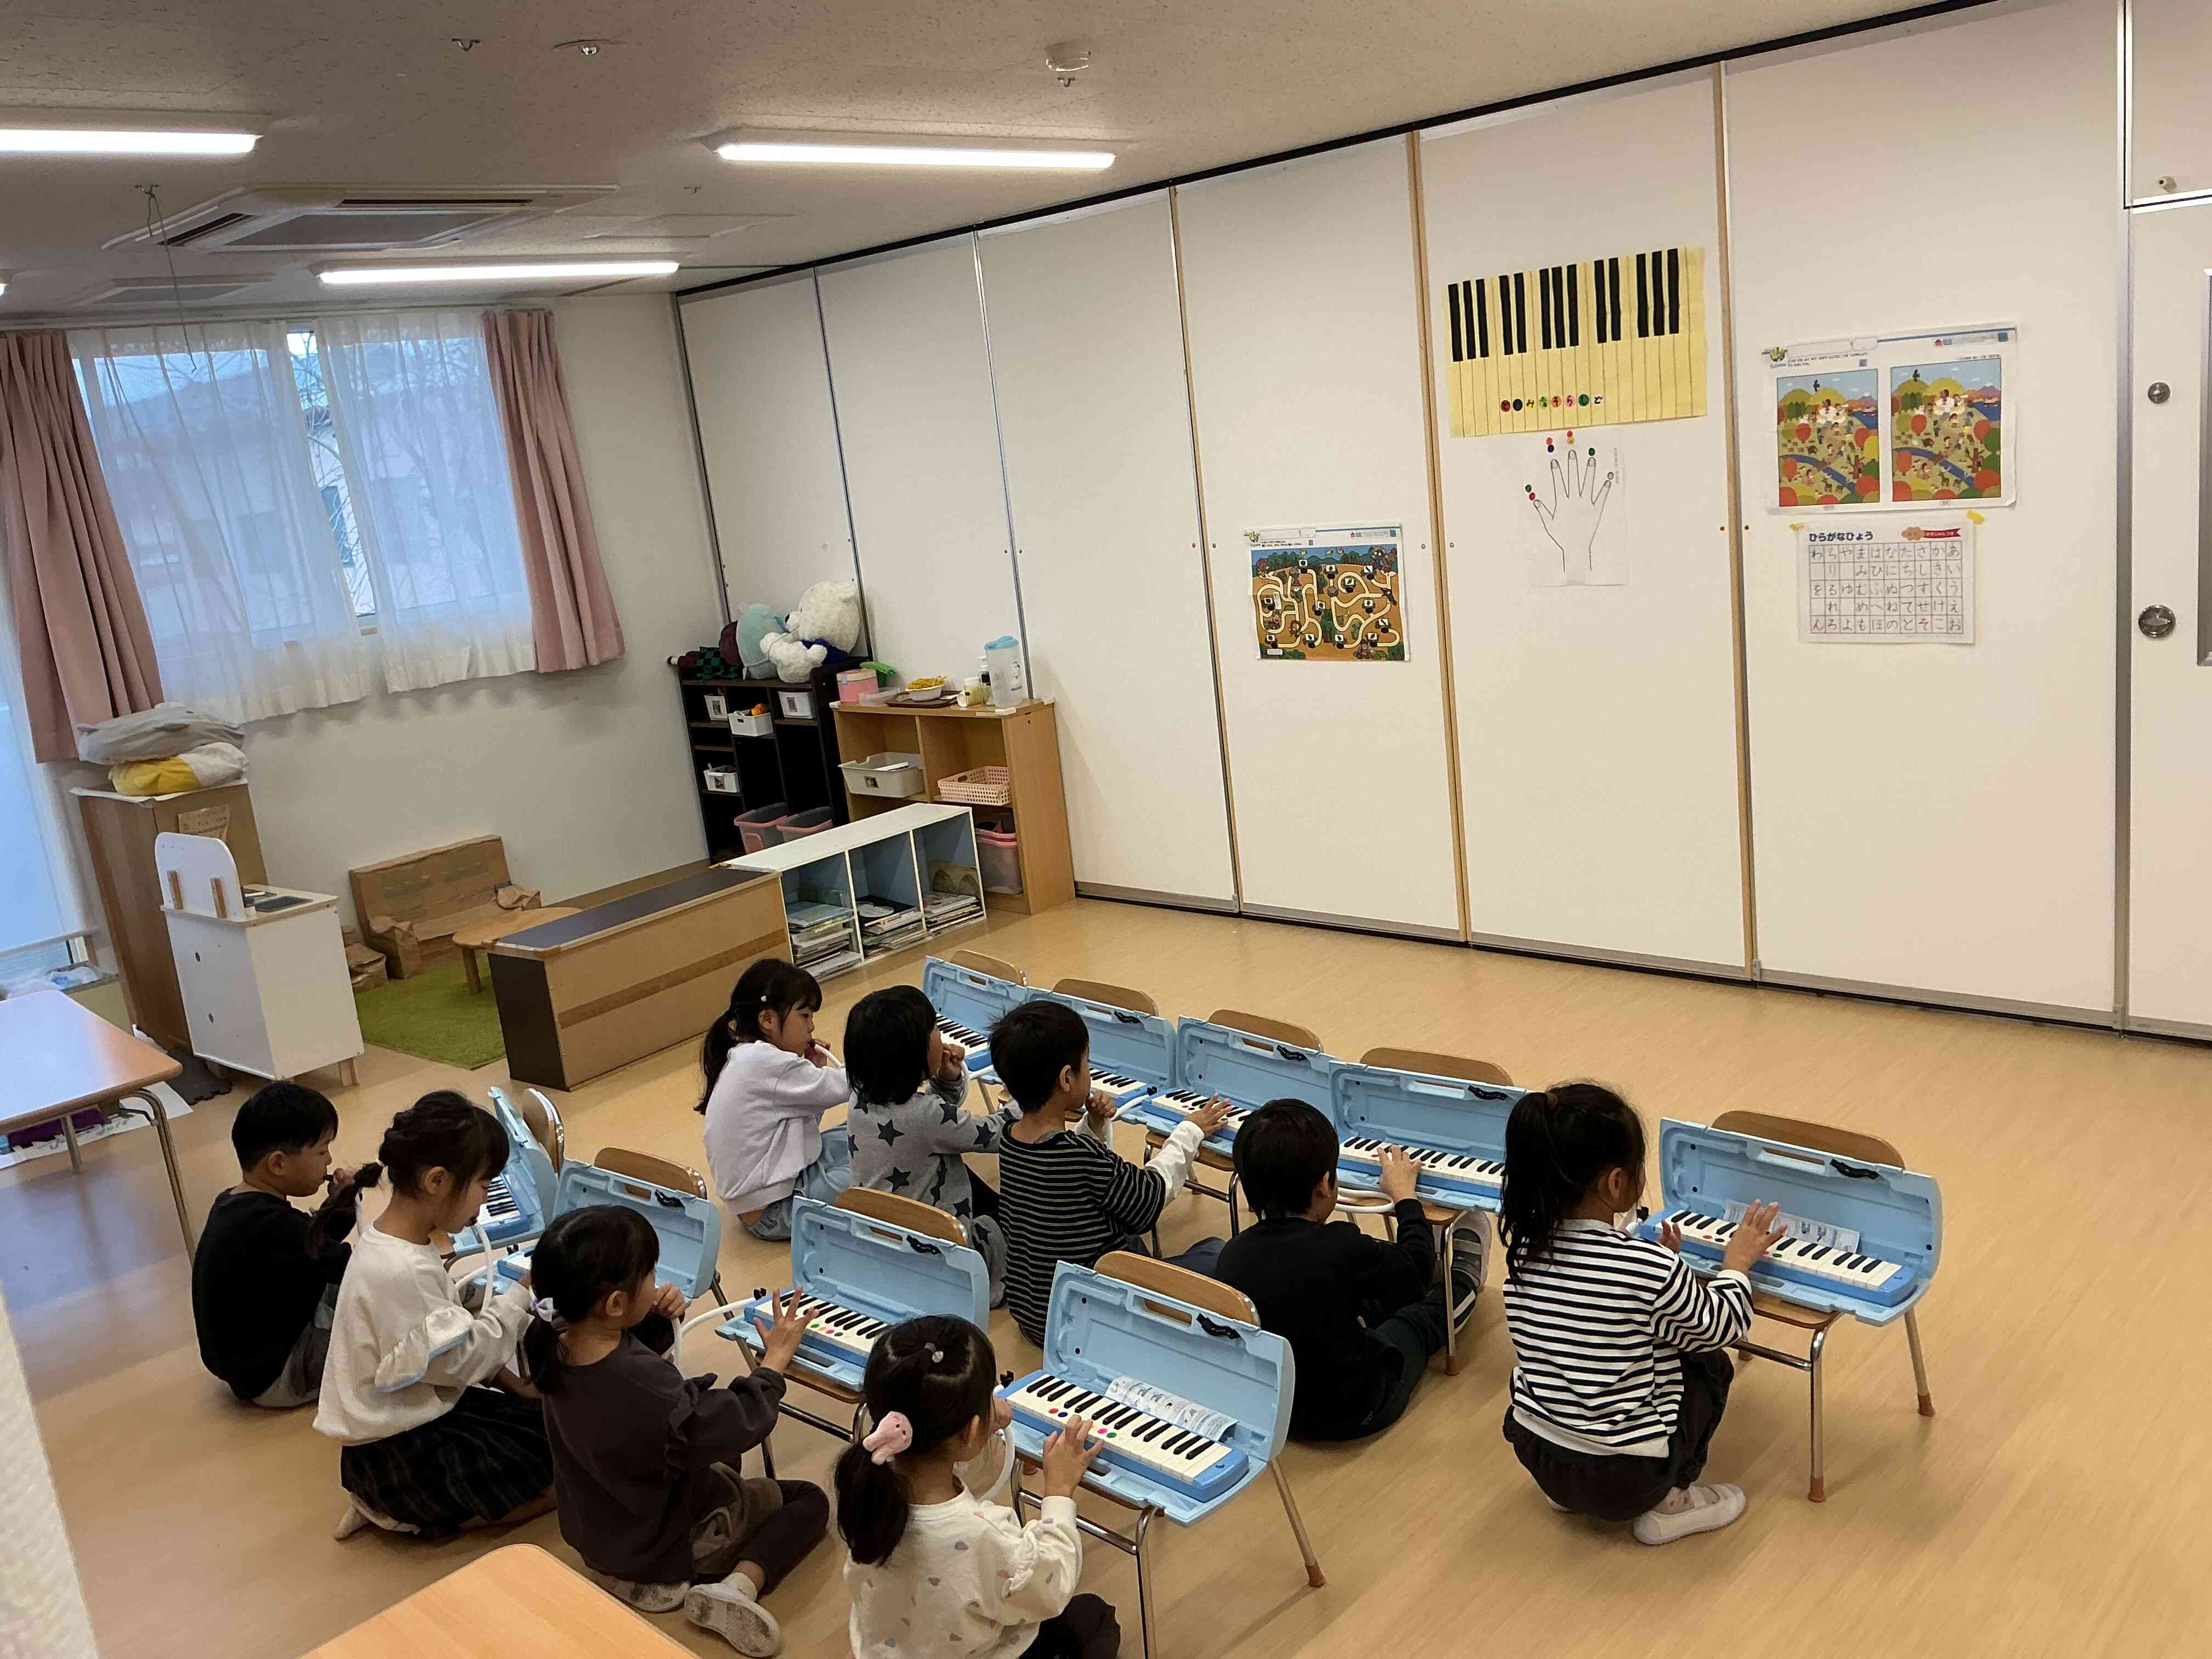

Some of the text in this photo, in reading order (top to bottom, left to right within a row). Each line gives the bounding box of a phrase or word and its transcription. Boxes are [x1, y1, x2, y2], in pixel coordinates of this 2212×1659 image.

[1809, 531, 1873, 542] ひらがなひょう
[1812, 549, 1822, 560] わ
[1841, 548, 1852, 559] や
[1856, 546, 1865, 559] ま
[1871, 547, 1880, 558] は
[1900, 545, 1912, 557] た
[1932, 547, 1945, 557] か
[1948, 543, 1960, 557] あ
[1829, 565, 1836, 577] り
[1857, 565, 1867, 576] み
[1871, 566, 1883, 577] ひ
[1886, 565, 1897, 575] に
[1902, 563, 1913, 575] ち
[1920, 563, 1927, 575] し
[1948, 565, 1960, 574] い
[1829, 584, 1837, 595] る
[1842, 584, 1853, 594] ゆ
[1857, 584, 1866, 595] む
[1901, 584, 1914, 592] つ
[1917, 582, 1930, 593] す
[1936, 582, 1942, 594] く
[1949, 581, 1958, 595] う
[1827, 601, 1838, 613] れ
[1857, 602, 1868, 612] め
[1887, 601, 1898, 612] ね
[1901, 601, 1912, 613] て
[1917, 601, 1931, 612] せ
[1933, 600, 1945, 612] け
[1950, 600, 1959, 613] え
[1813, 618, 1961, 631] ん ろ よ も ほ の と そ こ お
